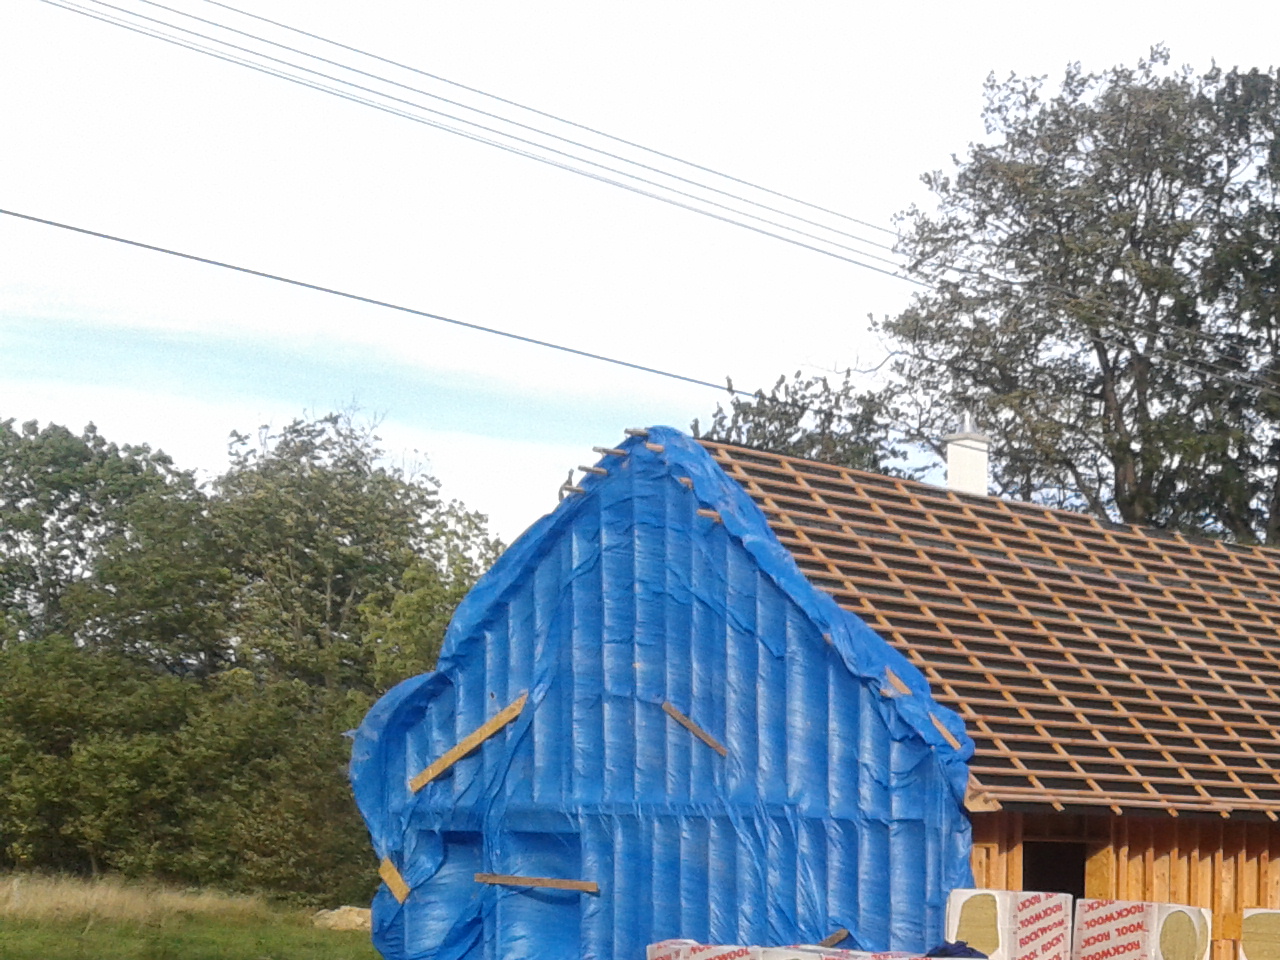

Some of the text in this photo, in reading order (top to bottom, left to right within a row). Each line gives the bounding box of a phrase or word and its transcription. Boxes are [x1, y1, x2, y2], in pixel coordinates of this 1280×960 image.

[1084, 903, 1144, 930] ROCKWOOL
[1081, 920, 1145, 949] ROCK WOOL
